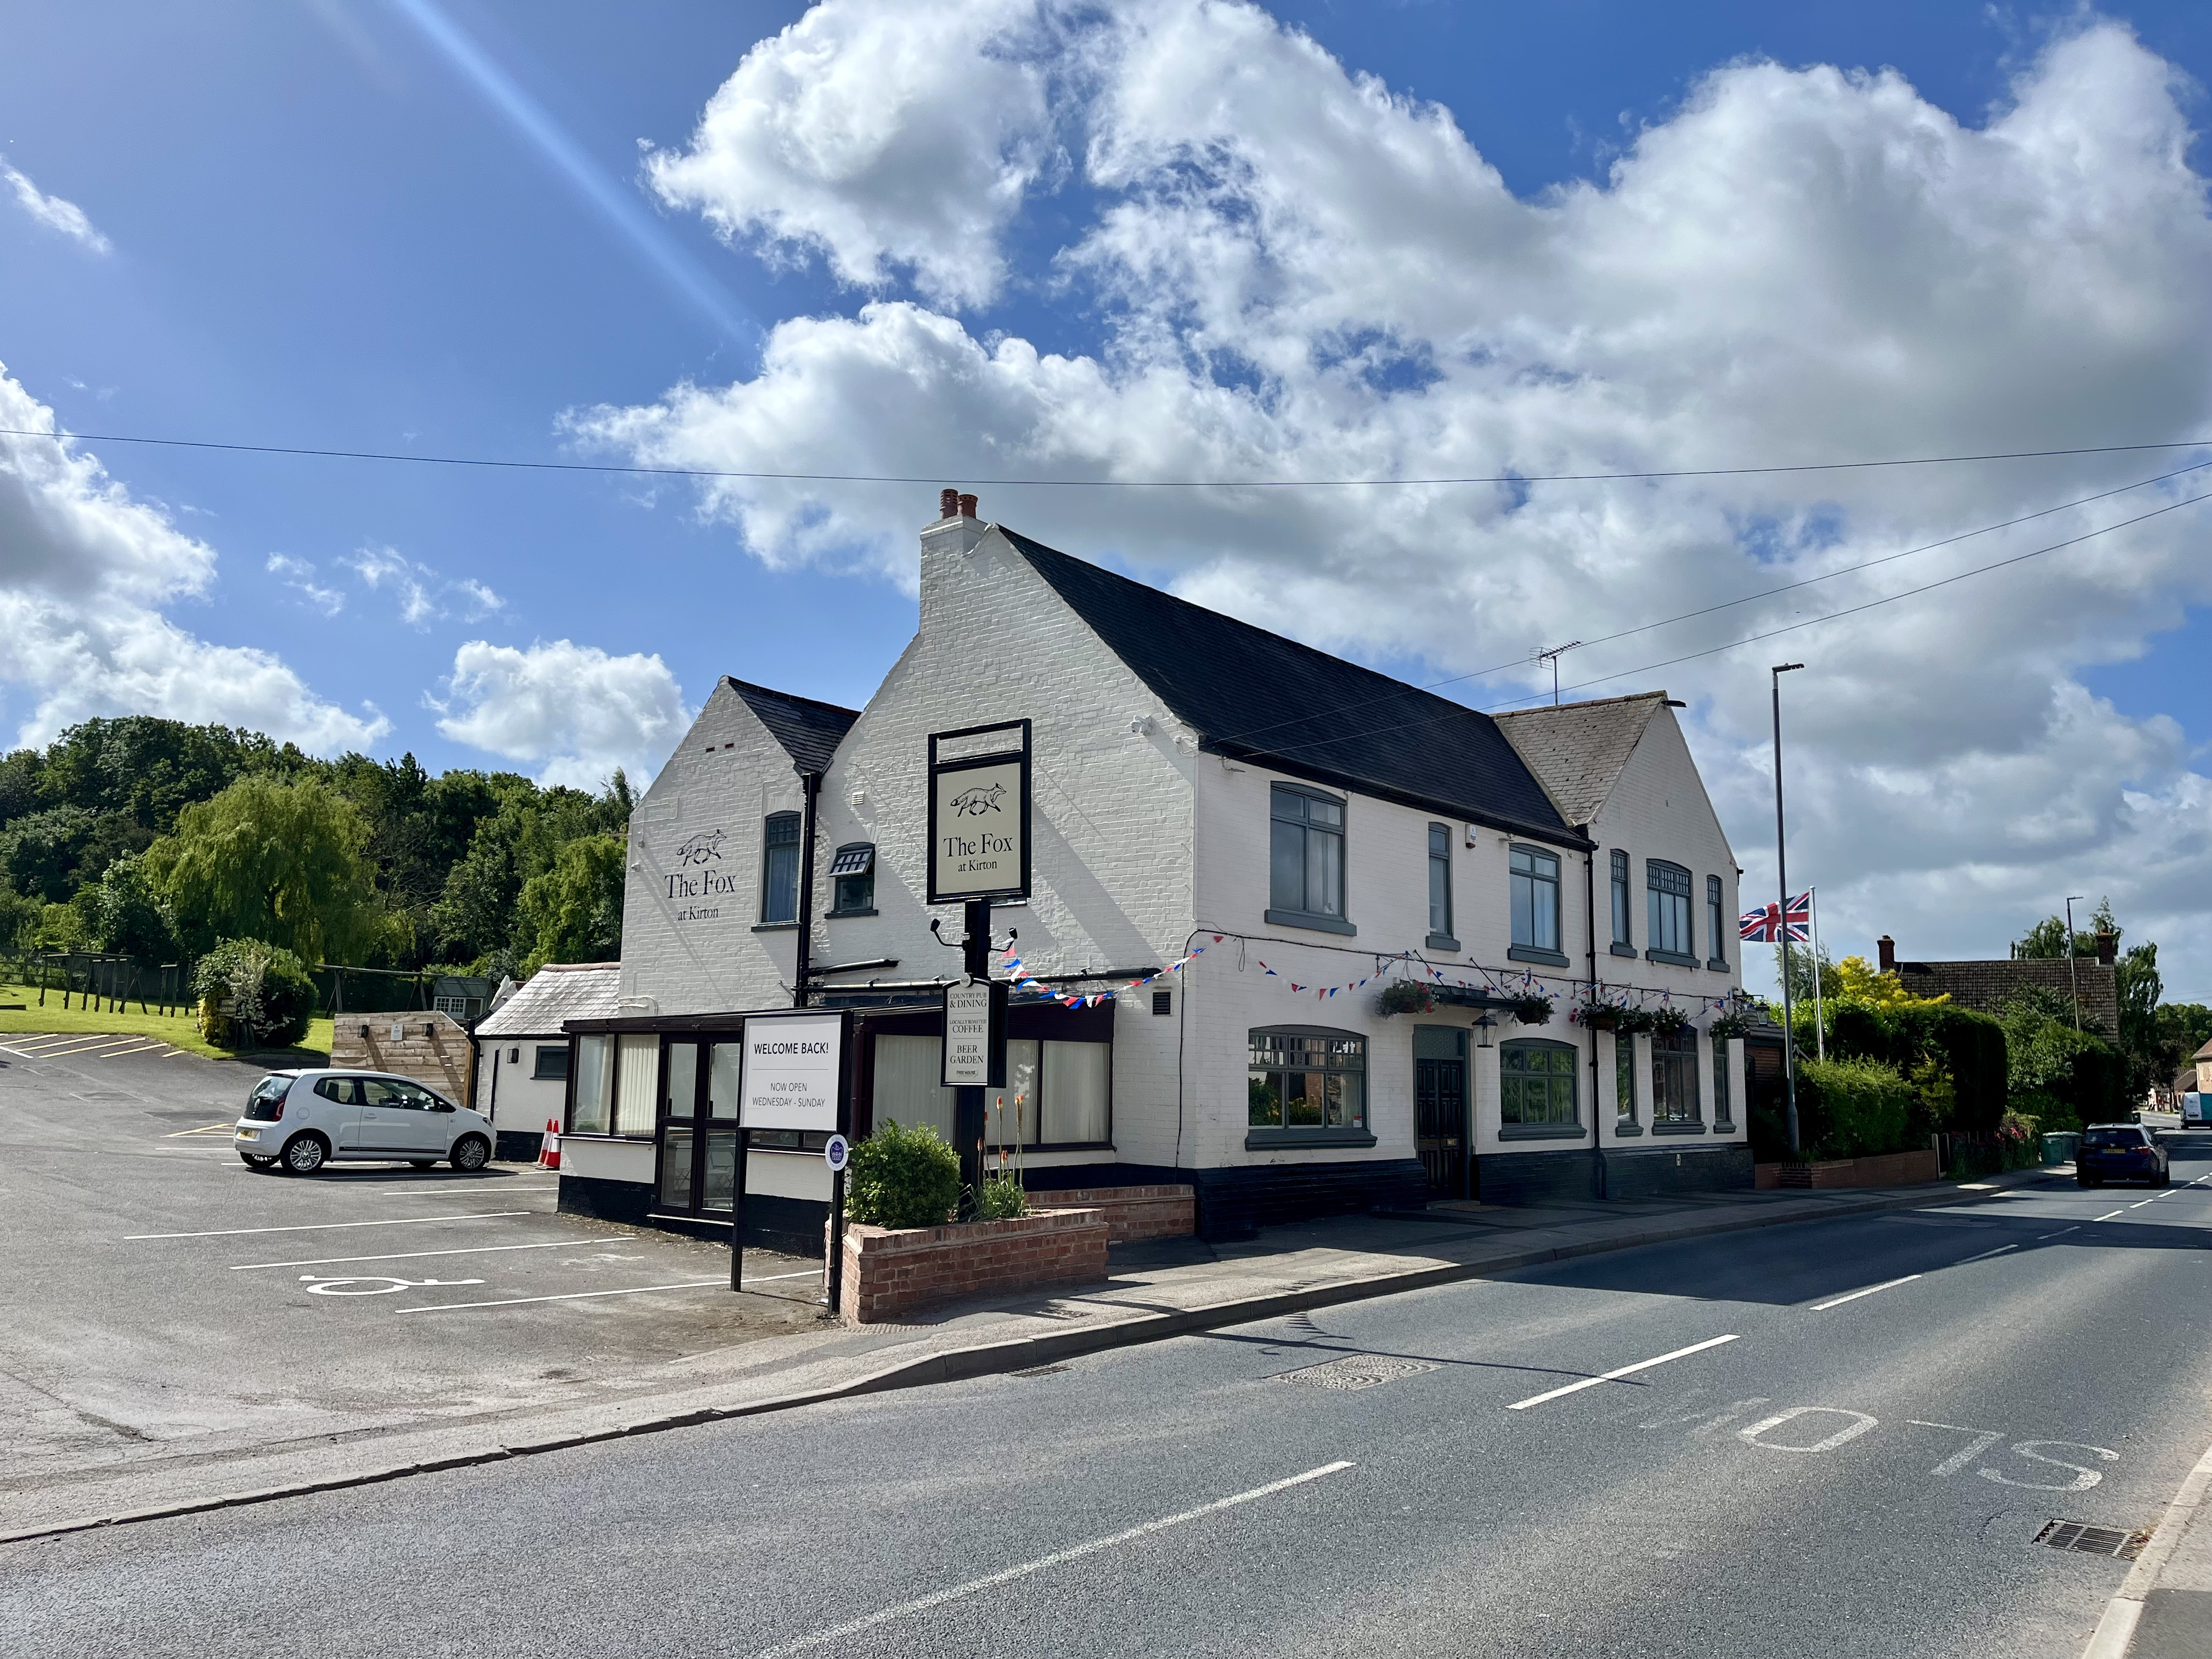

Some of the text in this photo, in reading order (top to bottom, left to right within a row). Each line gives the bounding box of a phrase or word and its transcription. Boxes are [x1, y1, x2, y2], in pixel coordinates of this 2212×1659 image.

[943, 833, 1013, 857] The Fox
[958, 859, 997, 872] at Kirton
[664, 870, 737, 899] The Fox
[678, 906, 719, 921] at Kirton
[950, 999, 987, 1008] & DINING
[952, 1024, 984, 1033] COFFEE
[754, 1042, 828, 1054] WELCOME BACK!
[957, 1045, 978, 1053] BEER
[950, 1055, 984, 1064] GARDEN
[770, 1082, 808, 1092] NOW OPEN
[752, 1097, 792, 1107] WEDNESDAY
[798, 1098, 825, 1107] SUNDAY
